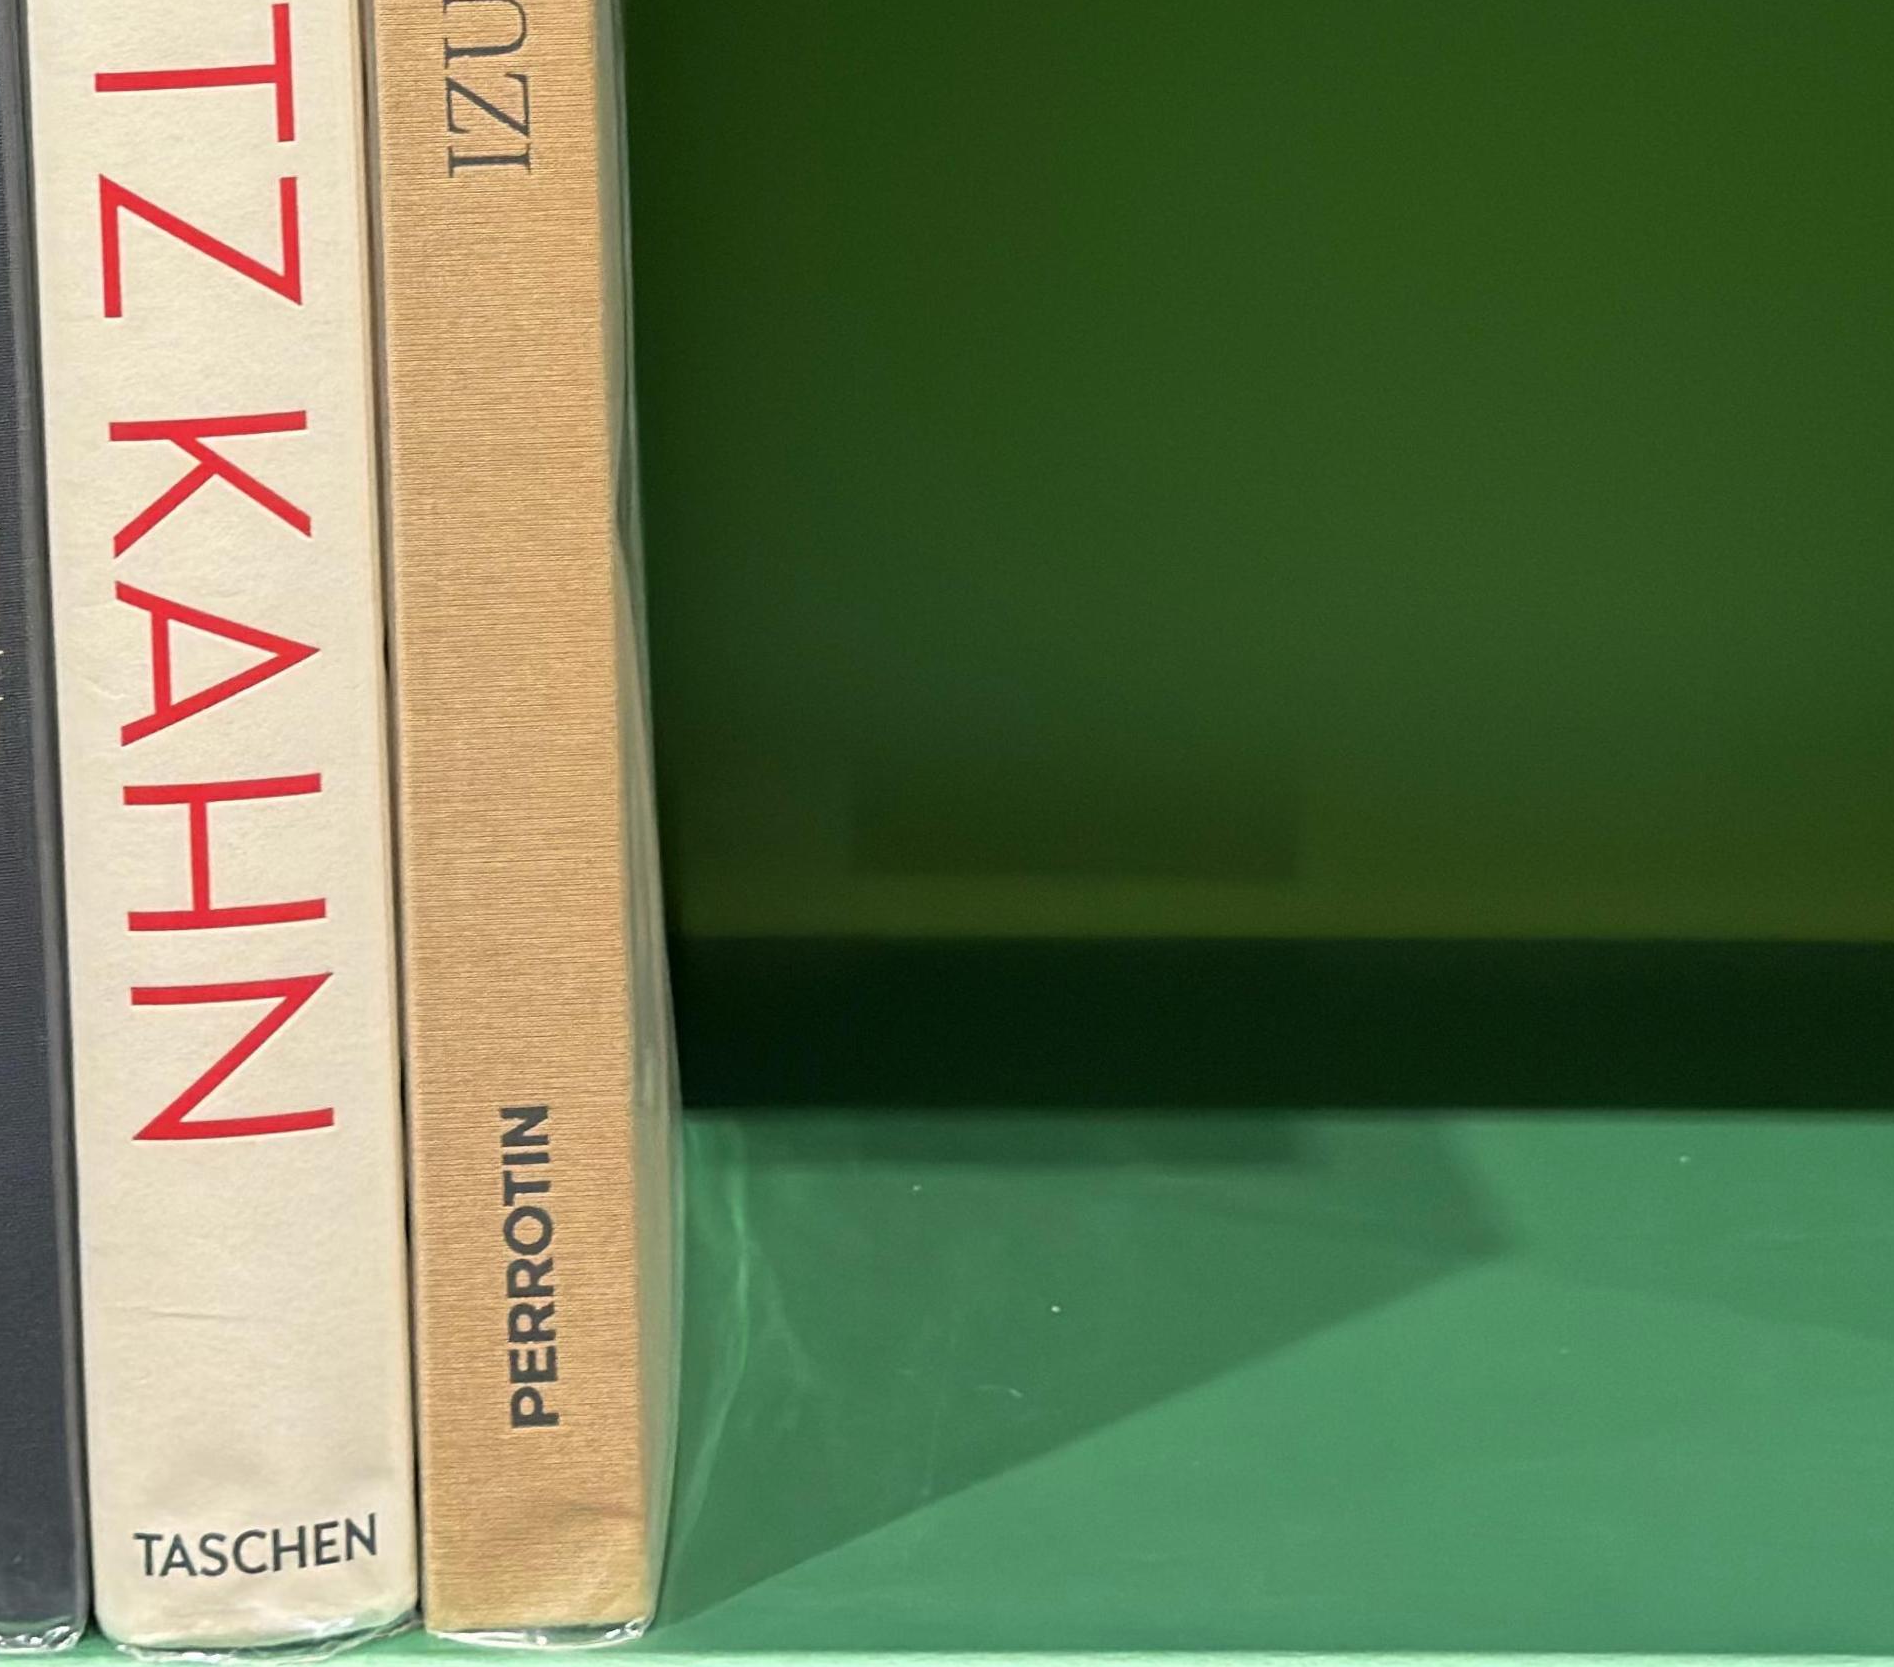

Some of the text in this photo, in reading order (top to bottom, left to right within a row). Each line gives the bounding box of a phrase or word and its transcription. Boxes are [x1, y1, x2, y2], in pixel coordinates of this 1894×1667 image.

[108, 409, 335, 1141] KAHN
[499, 1104, 560, 1428] PERROTIN
[133, 1512, 378, 1577] TASCHEN
